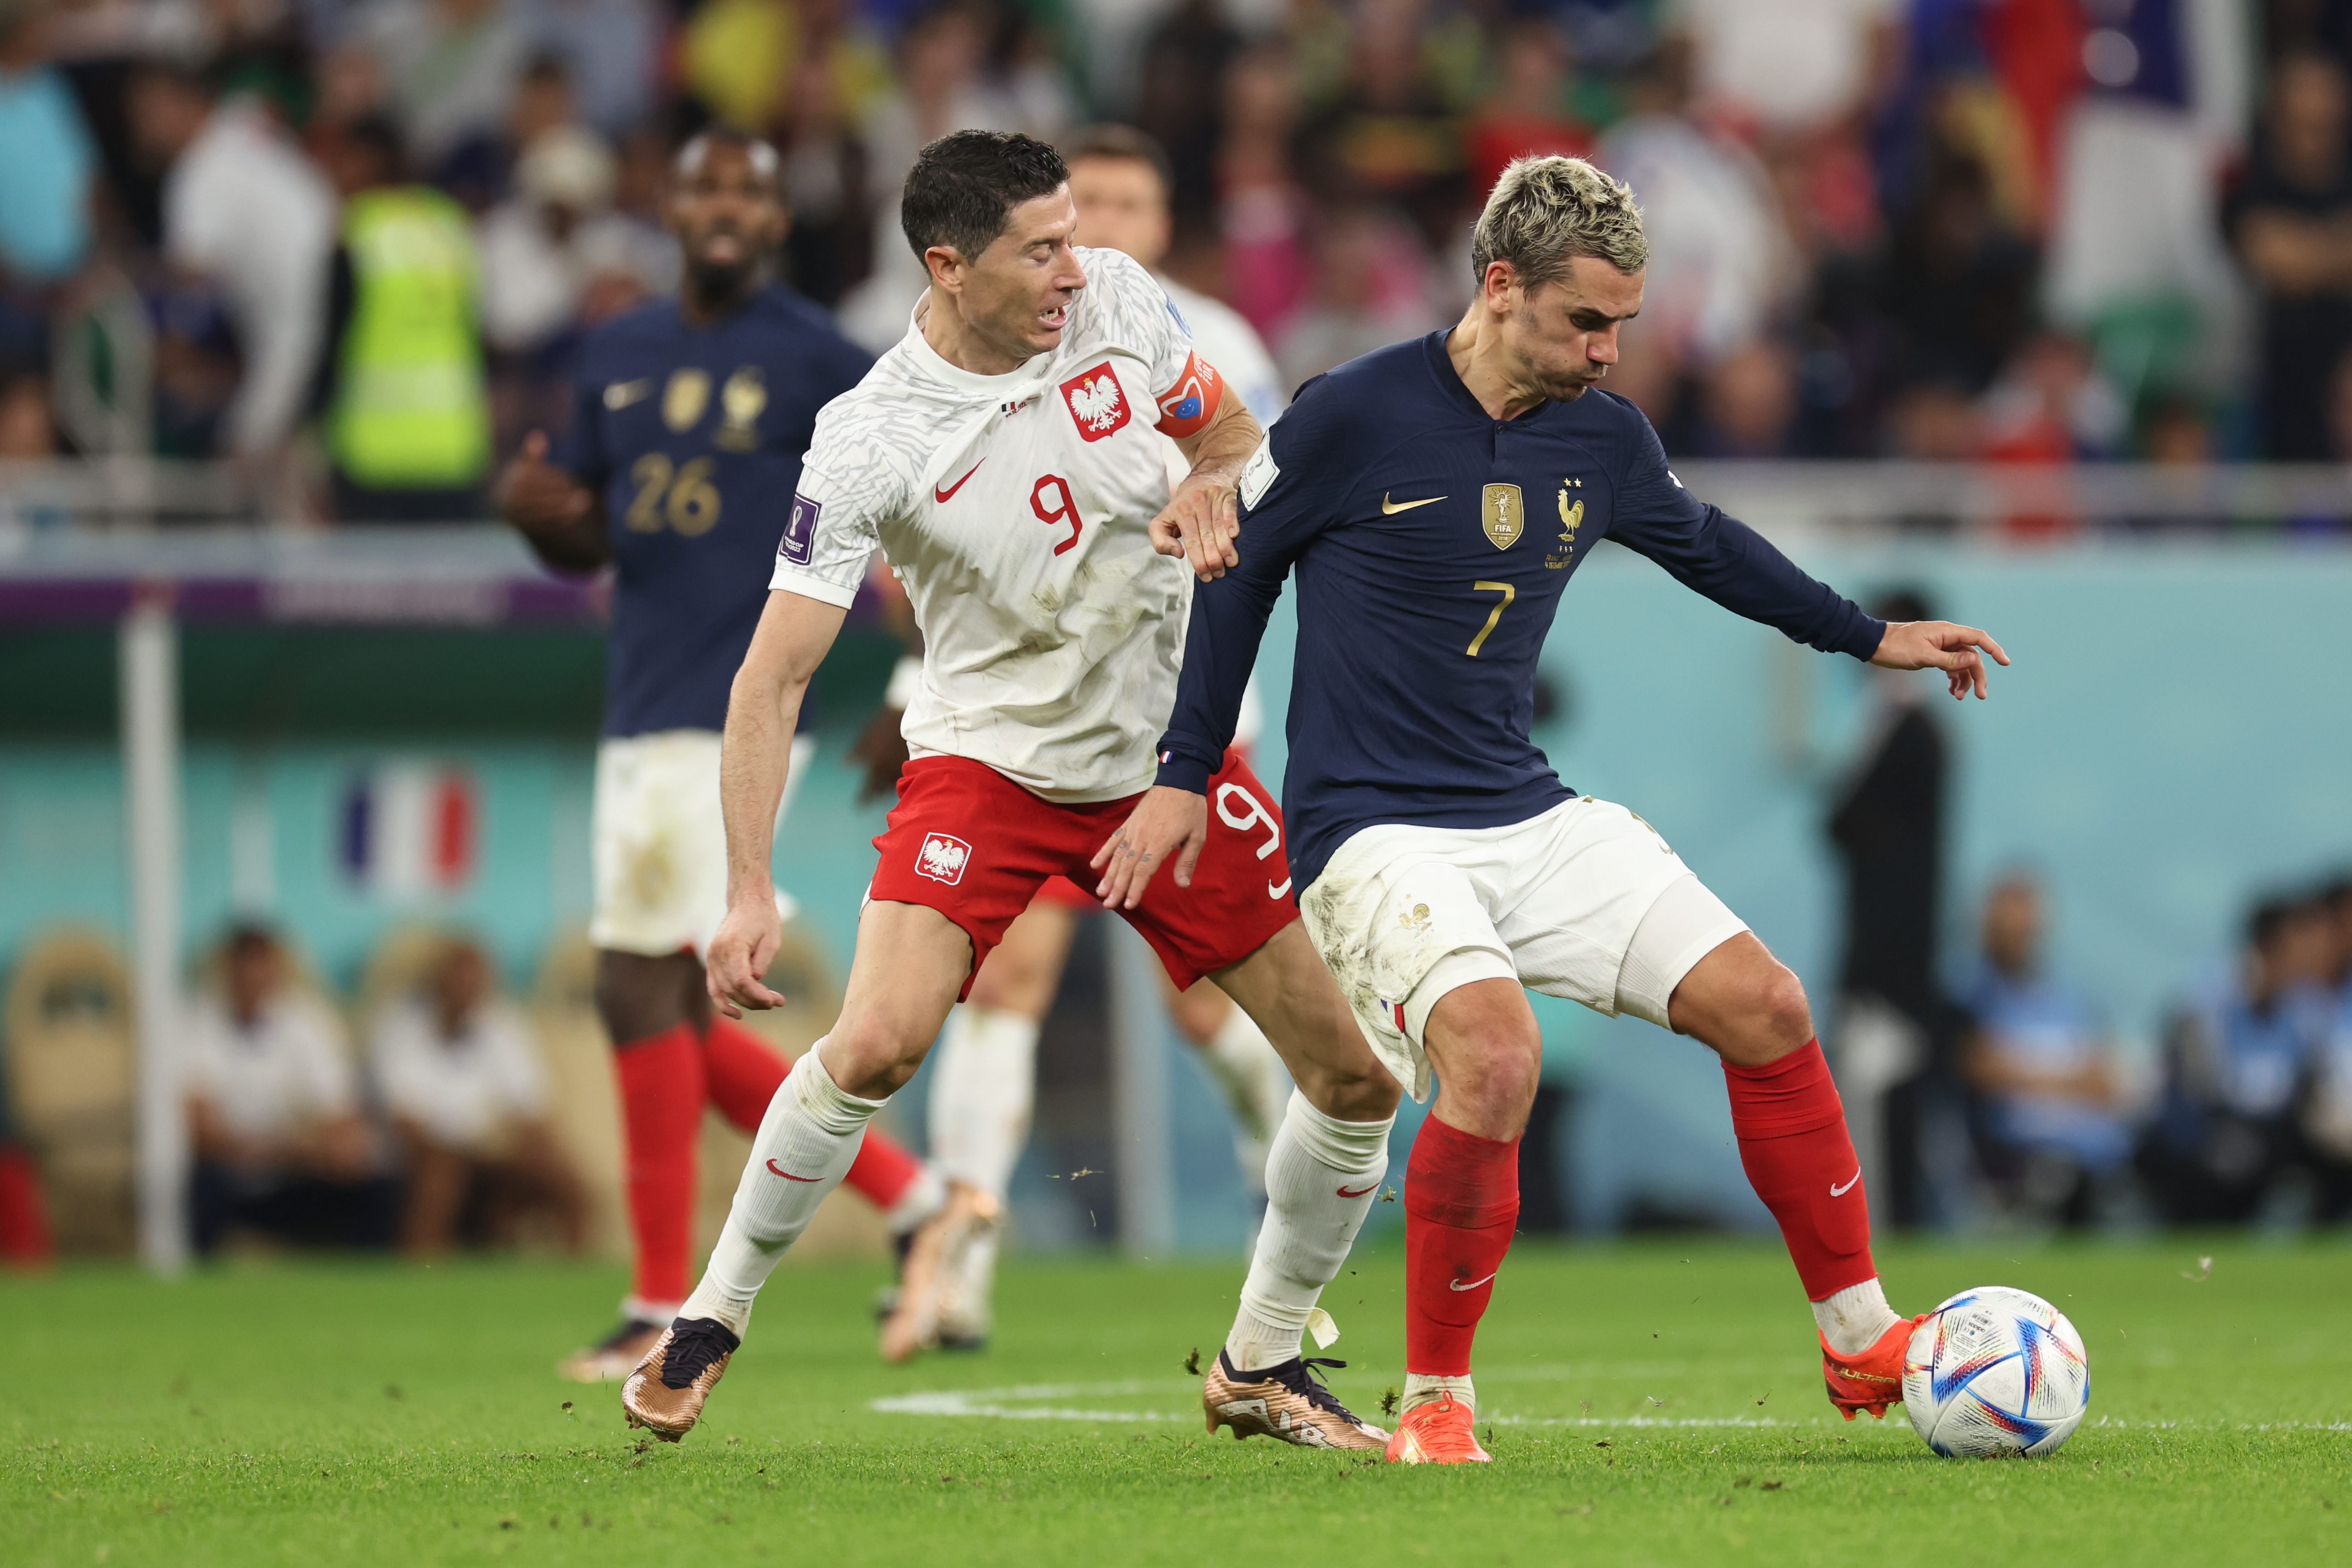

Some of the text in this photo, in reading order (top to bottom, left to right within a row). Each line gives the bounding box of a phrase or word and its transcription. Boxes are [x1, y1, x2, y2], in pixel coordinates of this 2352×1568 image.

[1202, 364, 1214, 387] FOR
[625, 452, 722, 536] 26
[1030, 474, 1083, 556] 9
[1466, 580, 1515, 656] 7
[1216, 782, 1280, 861] 9
[1969, 1322, 1985, 1333] adidas
